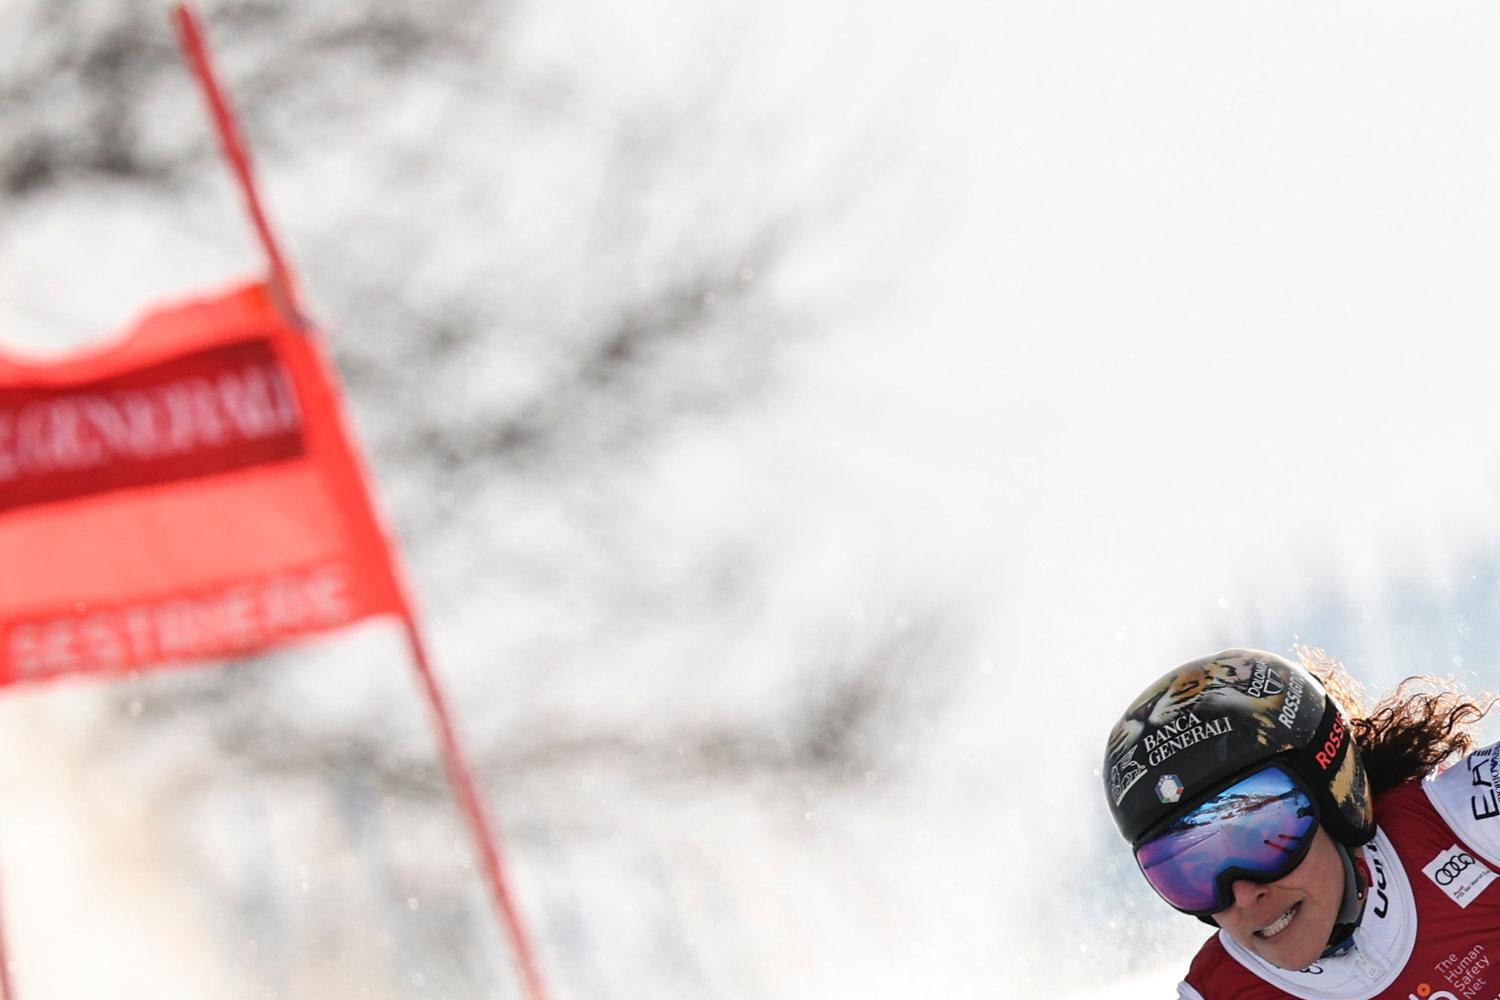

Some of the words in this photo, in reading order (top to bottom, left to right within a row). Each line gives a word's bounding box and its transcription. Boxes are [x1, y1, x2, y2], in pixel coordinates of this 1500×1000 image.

[1144, 712, 1202, 752] BANCA
[1148, 717, 1234, 767] GENERALI
[1434, 953, 1458, 973] The
[1444, 944, 1484, 983] Human
[1454, 955, 1490, 992] Safety
[1463, 977, 1487, 999] Net
